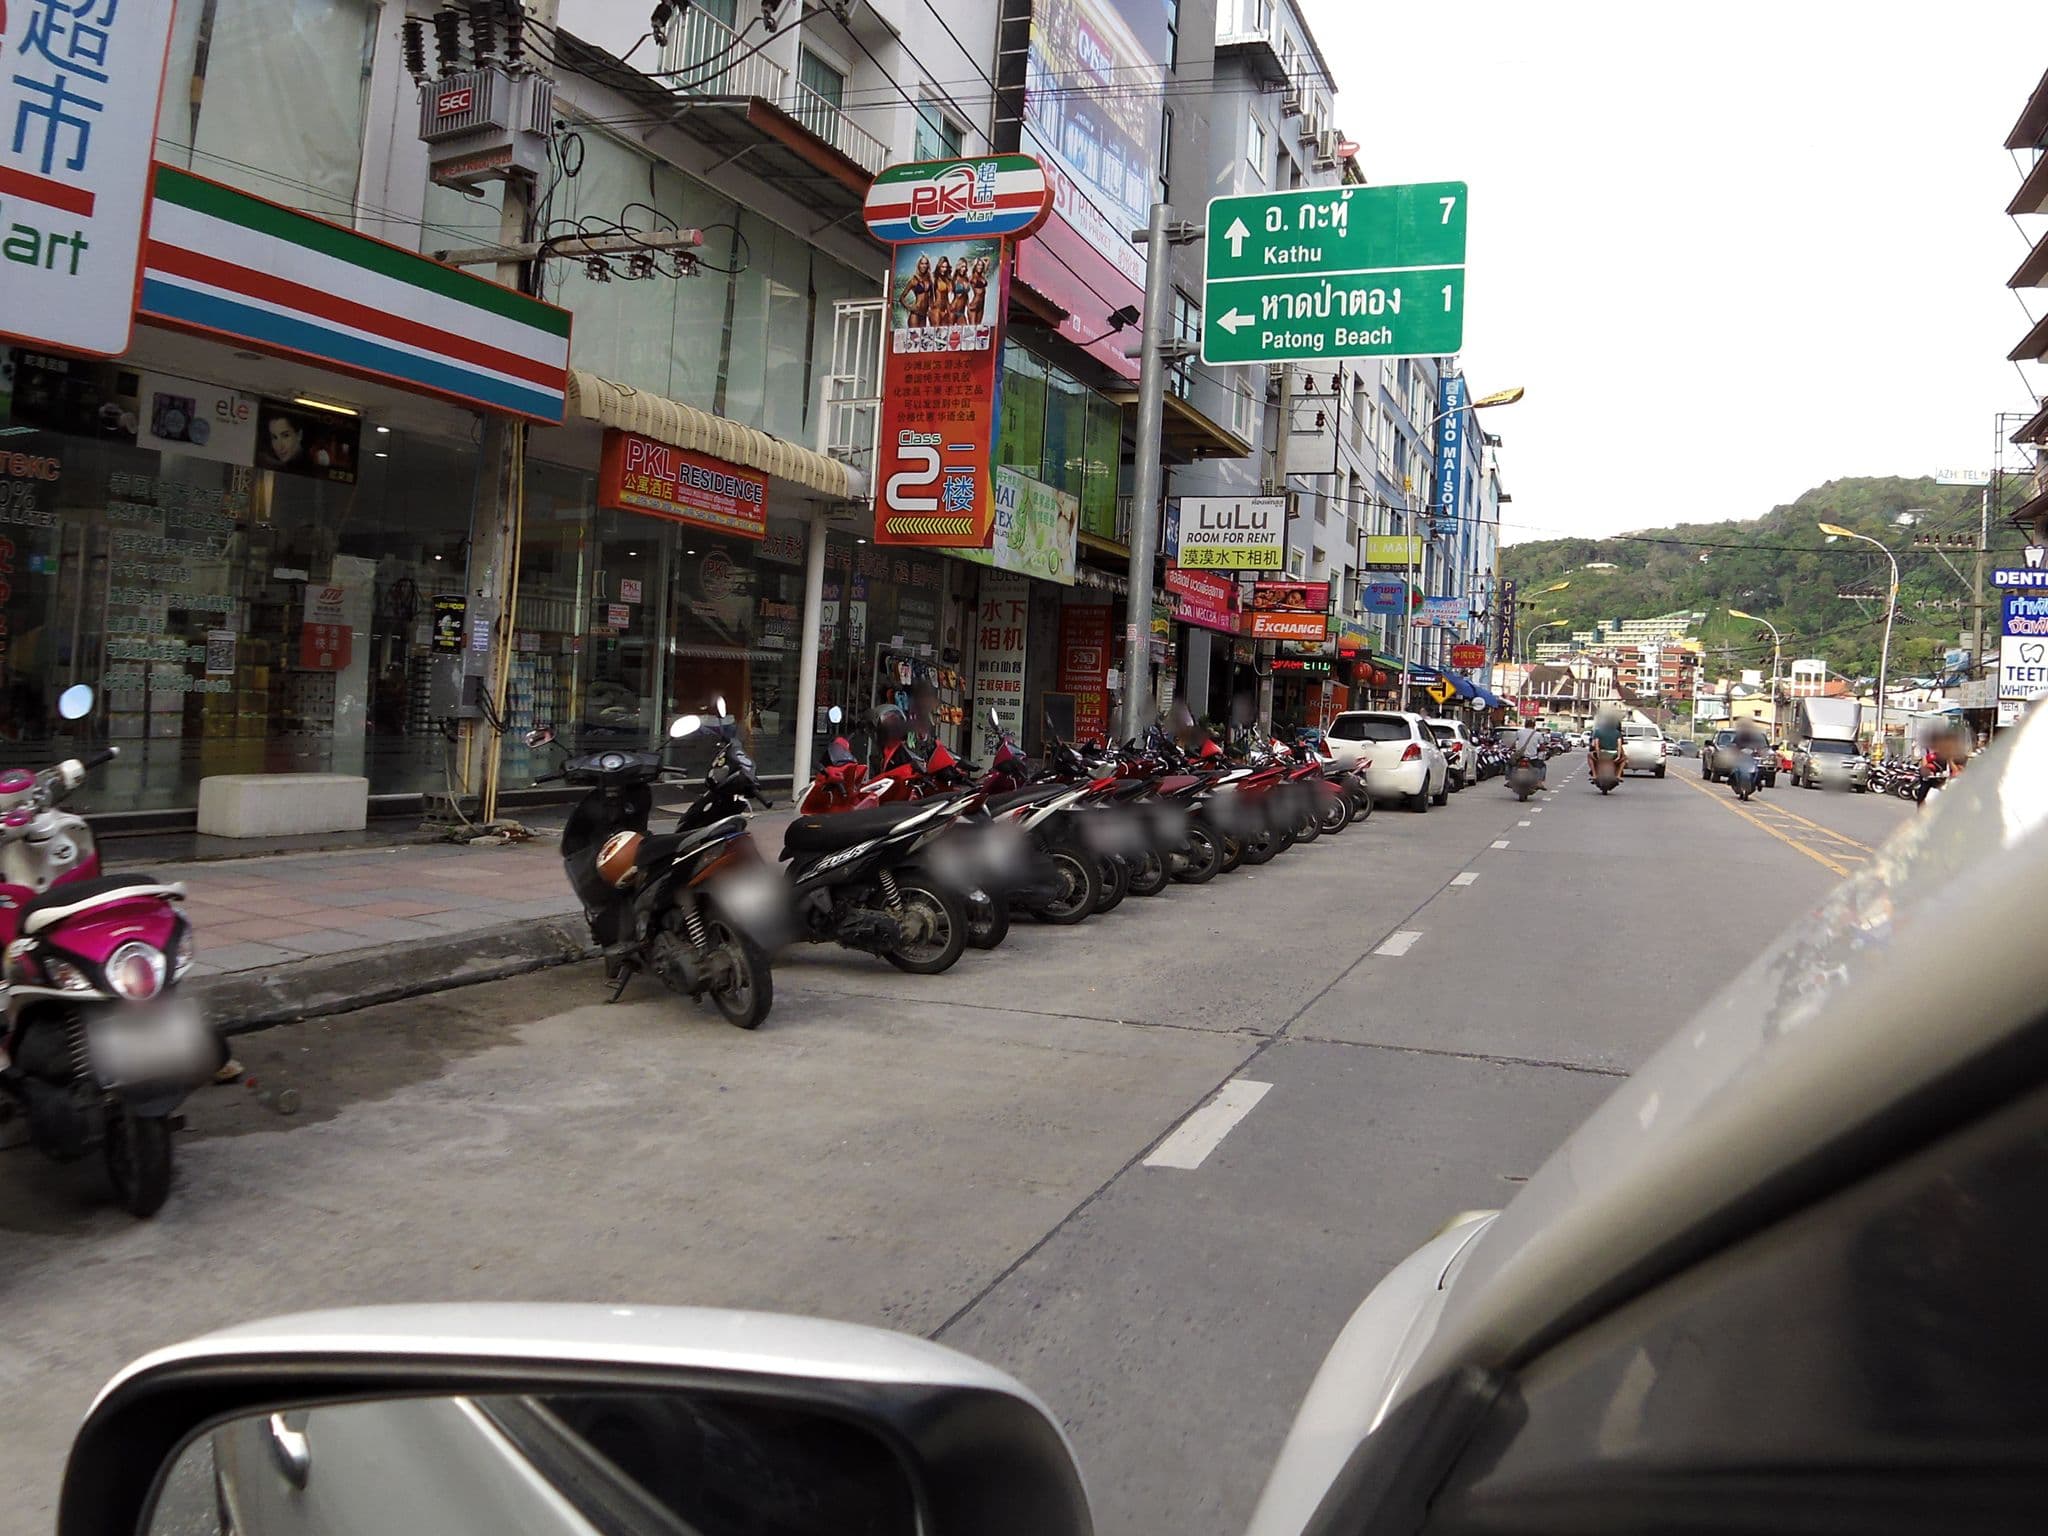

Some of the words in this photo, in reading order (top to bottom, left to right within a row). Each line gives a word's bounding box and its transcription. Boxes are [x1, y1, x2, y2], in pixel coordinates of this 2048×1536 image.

[440, 92, 470, 112] SEC
[977, 162, 998, 204] 超市
[910, 182, 996, 214] PKL
[1439, 196, 1456, 225] 7
[965, 210, 994, 223] Mart
[1265, 206, 1289, 232] อ.
[1299, 190, 1354, 238] กะทู้
[2, 223, 89, 276] art
[1264, 246, 1322, 265] Kathu
[1261, 279, 1401, 321] หาดป่าตอง
[1441, 284, 1452, 312] 1
[1262, 330, 1325, 351] Patong
[1335, 326, 1392, 346] Beach
[1445, 395, 1458, 441] SINO
[899, 430, 942, 446] Class
[626, 438, 677, 482] PKL
[679, 462, 764, 504] RESIDENCE
[886, 446, 941, 511] 2
[942, 443, 976, 513] 二楼
[1936, 468, 1978, 480] AZHTEL
[624, 473, 674, 500] 公寓酒店
[1199, 504, 1268, 530] LuLu
[1187, 532, 1220, 543] ROOM
[1223, 532, 1244, 543] FOR
[1247, 532, 1276, 543] RENT
[623, 581, 640, 592] PKL
[982, 599, 1026, 623] 水下
[980, 627, 1024, 651] 相机
[2006, 666, 2048, 682] TEET
[2001, 684, 2048, 696] WHITE
